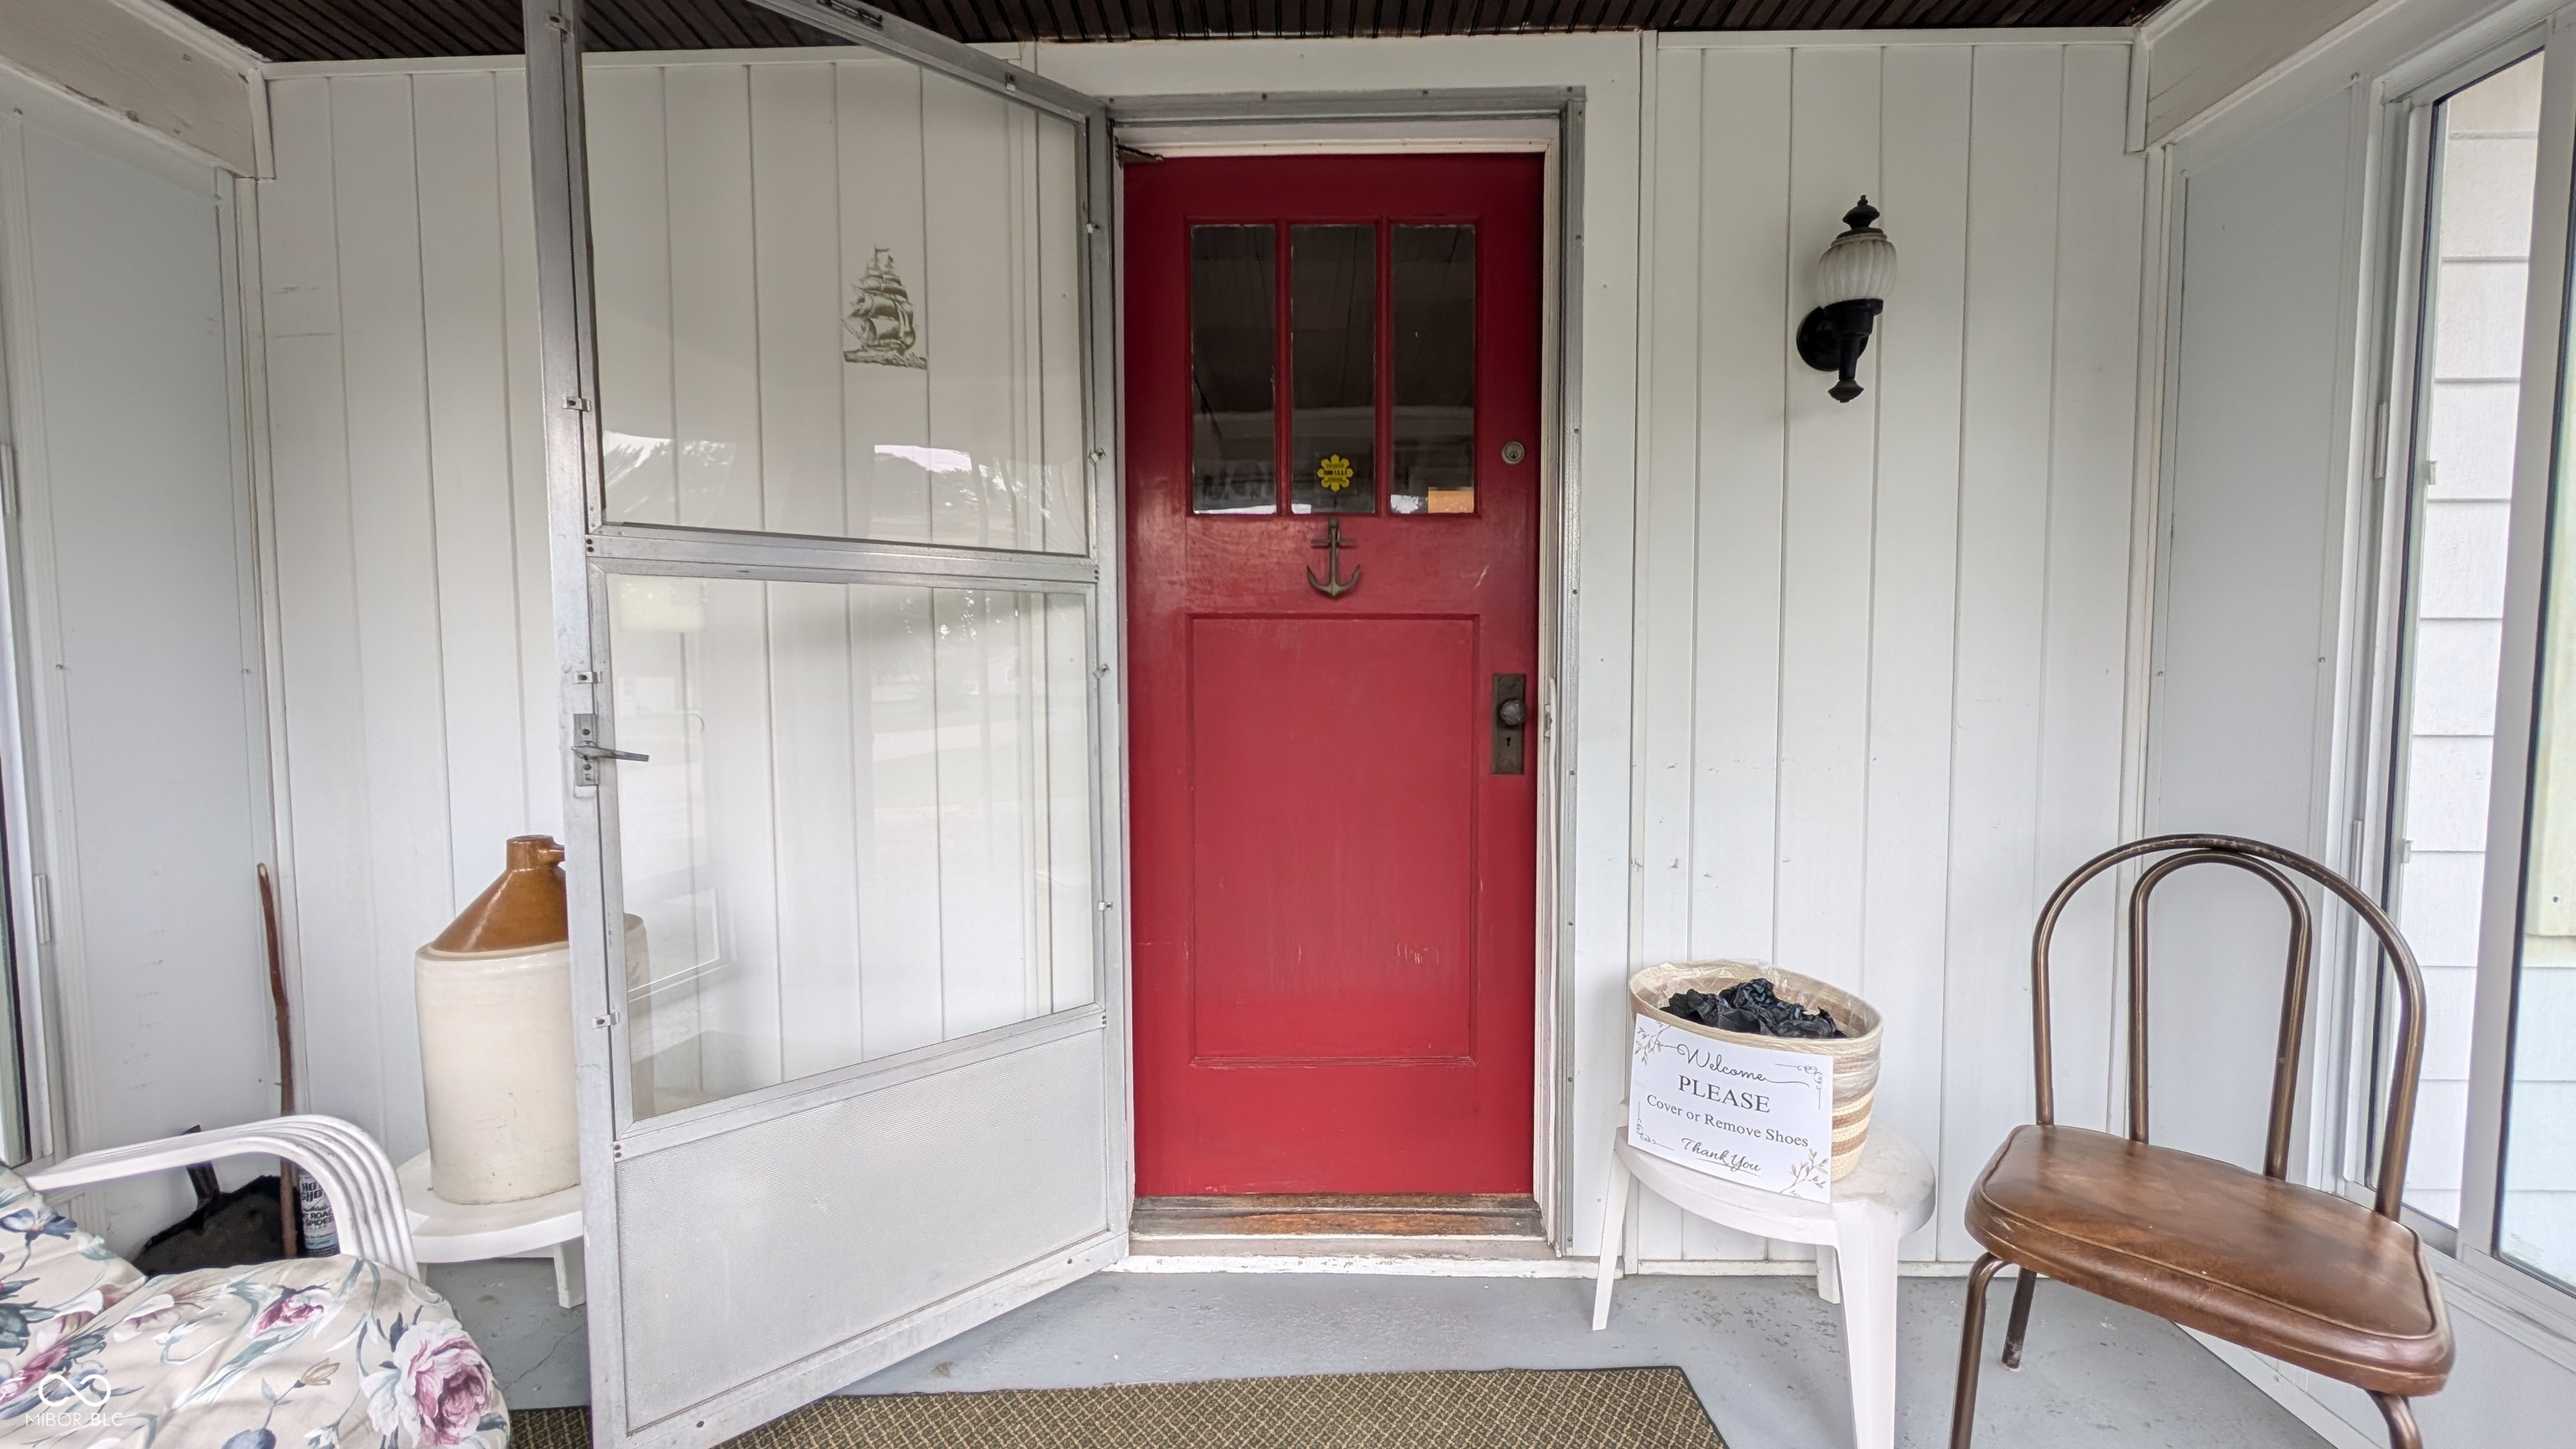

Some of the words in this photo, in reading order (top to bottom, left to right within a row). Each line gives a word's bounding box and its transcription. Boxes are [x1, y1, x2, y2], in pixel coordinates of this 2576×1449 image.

[1676, 1043, 1779, 1083] Welcome
[1678, 1074, 1771, 1114] PLEASE
[1647, 1094, 1683, 1116] Cover
[1685, 1109, 1701, 1122] or
[1704, 1113, 1762, 1138] Remove
[1765, 1128, 1809, 1147] Shoes
[1681, 1137, 1729, 1166] Thank
[1729, 1153, 1762, 1172] You
[301, 1182, 322, 1192] HO
[301, 1188, 326, 1202] SHO
